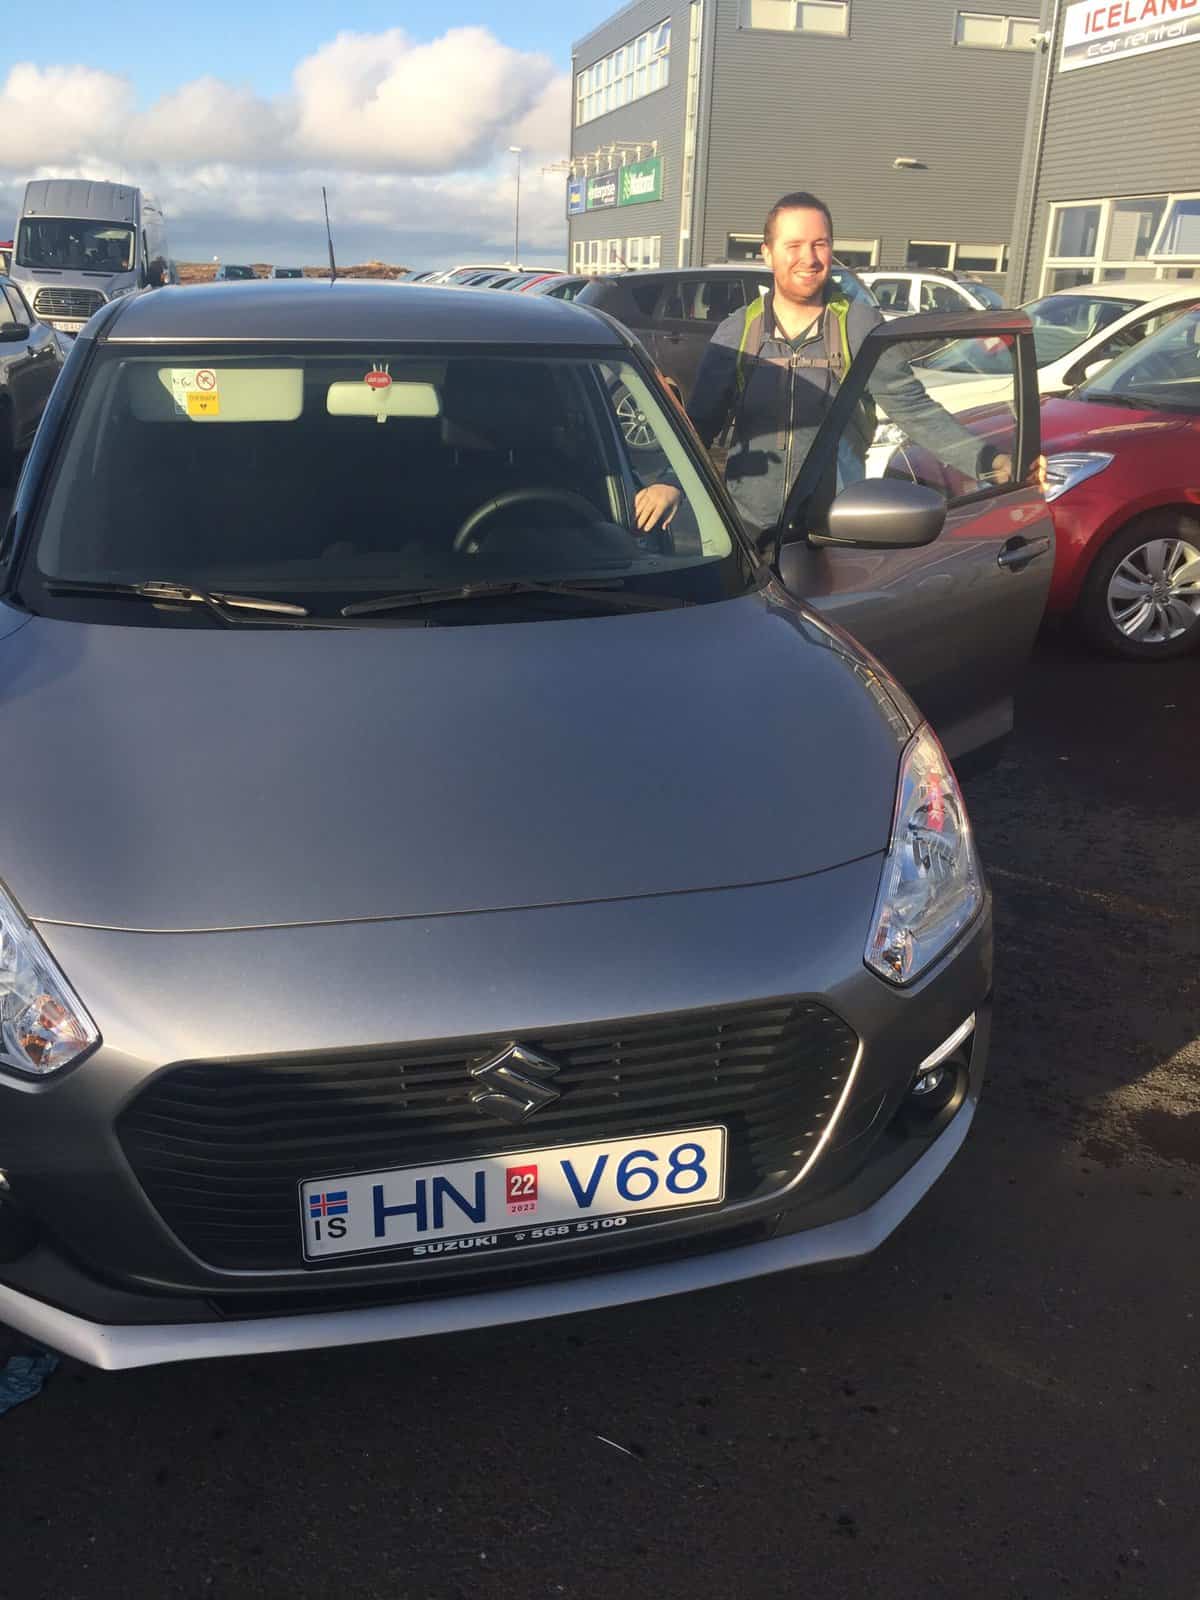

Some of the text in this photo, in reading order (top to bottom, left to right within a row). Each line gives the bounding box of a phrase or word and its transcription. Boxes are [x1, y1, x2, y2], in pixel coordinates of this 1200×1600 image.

[1087, 22, 1188, 57] car rental
[373, 1142, 708, 1237] HN V68
[511, 1174, 535, 1196] 22
[314, 1217, 348, 1241] IS
[413, 1217, 628, 1256] SUZUKI 568 5100
